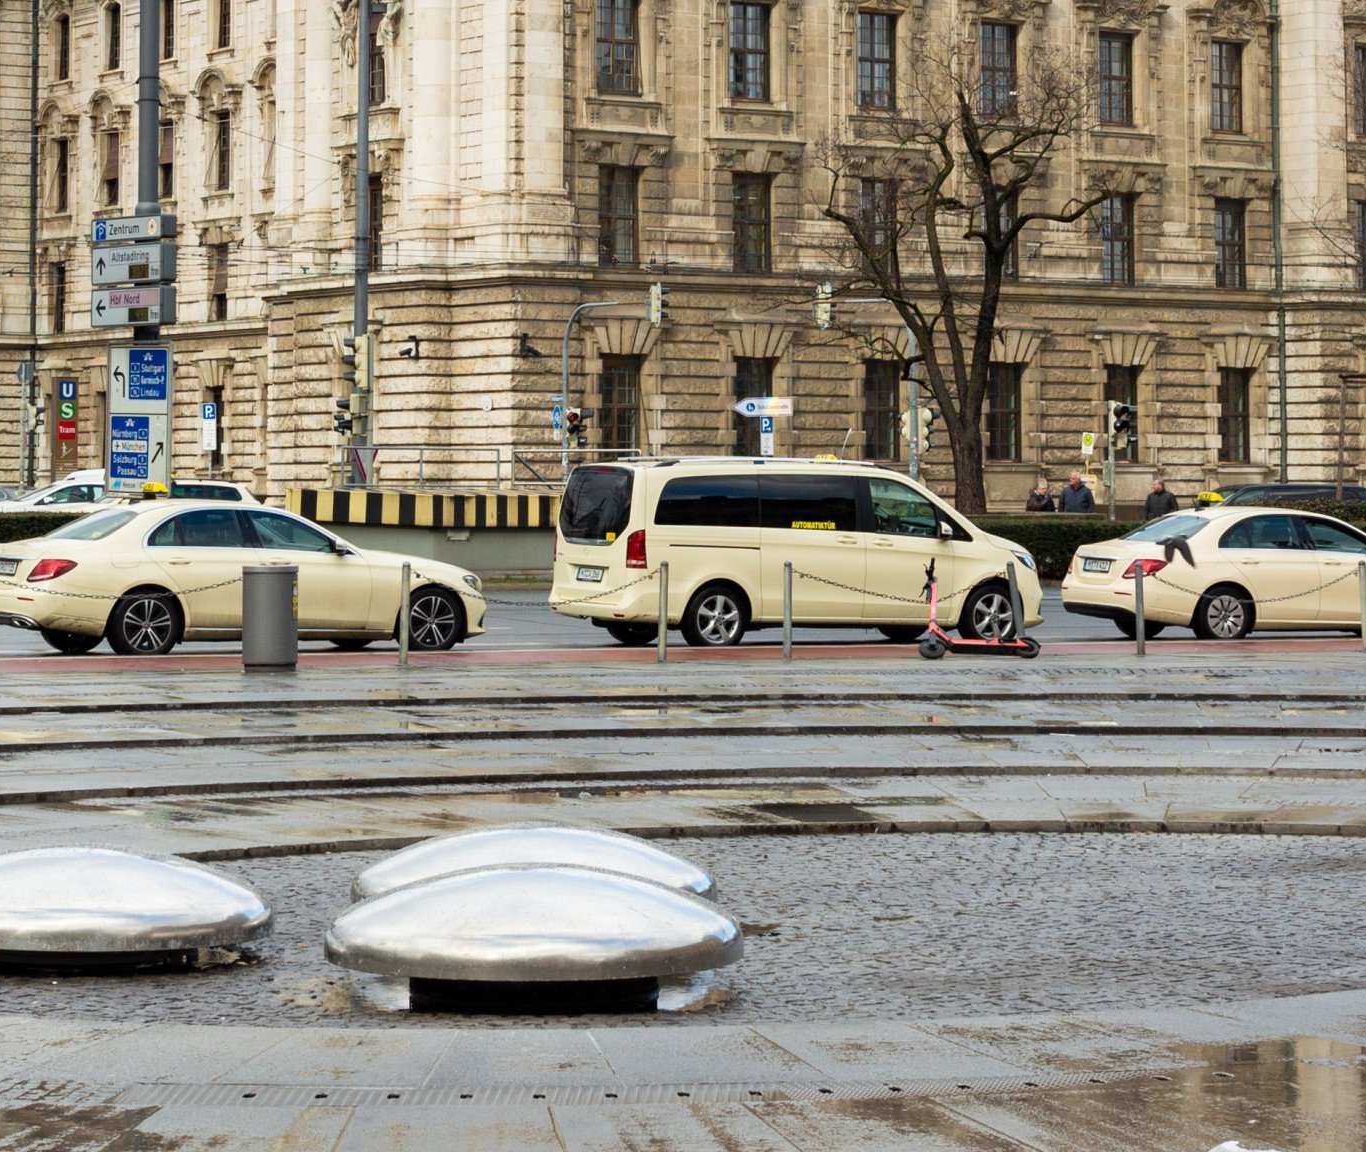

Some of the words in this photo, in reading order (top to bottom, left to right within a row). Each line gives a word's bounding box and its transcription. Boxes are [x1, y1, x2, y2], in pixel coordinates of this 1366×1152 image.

[109, 224, 140, 236] Zentrum
[111, 251, 150, 263] Altstadtring
[151, 265, 160, 276] frei
[110, 294, 122, 305] Hbf
[124, 293, 140, 304] Nord
[150, 309, 159, 319] frei
[141, 363, 165, 375] Stuttgart
[62, 383, 73, 398] U
[141, 388, 159, 397] Lindau
[61, 402, 74, 419] S
[205, 405, 213, 418] P
[59, 425, 76, 434] Tram
[762, 418, 770, 432] P
[112, 429, 138, 440] Nürnberg
[121, 442, 145, 451] München
[112, 453, 137, 466] Salzburg
[117, 466, 137, 476] Passau
[792, 521, 836, 530] AUTOMATIKTÜR
